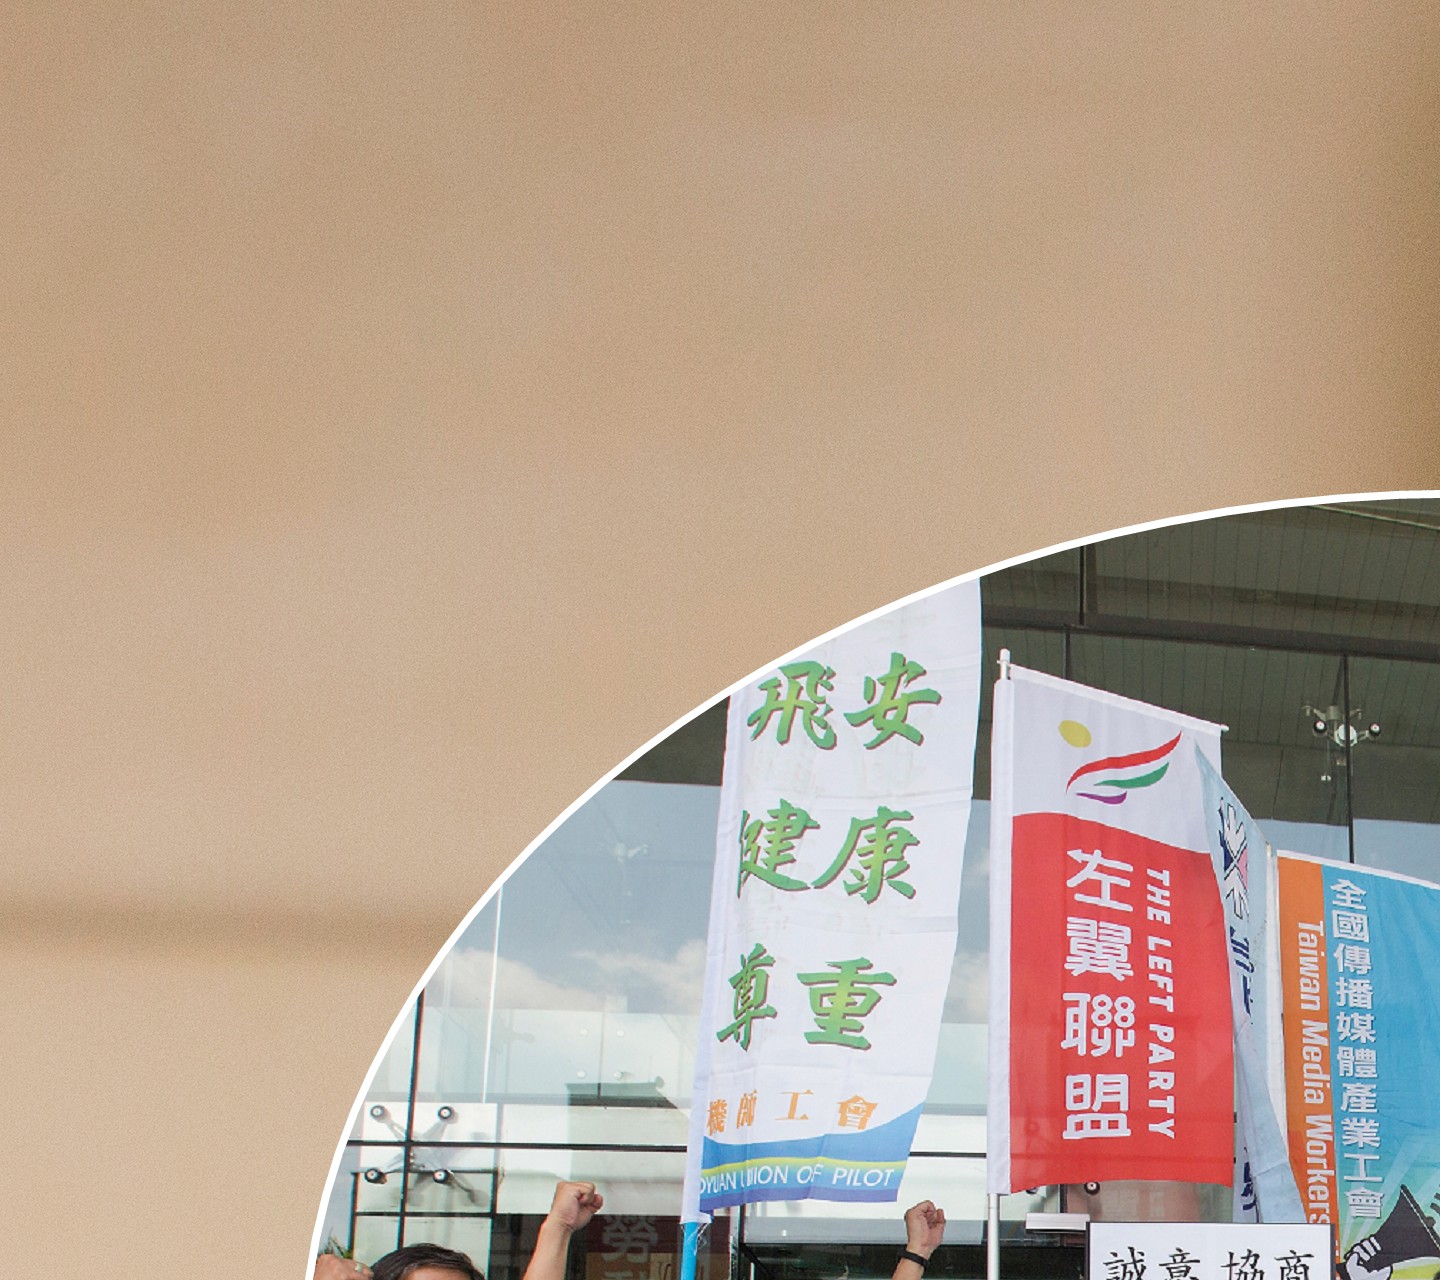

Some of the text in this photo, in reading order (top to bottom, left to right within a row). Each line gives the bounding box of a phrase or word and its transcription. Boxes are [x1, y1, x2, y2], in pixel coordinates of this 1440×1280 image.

[747, 652, 943, 750] 飛安
[737, 798, 920, 904] 健康
[716, 942, 898, 1052] 尊重
[1062, 849, 1136, 1140] 左翼聯盟
[1145, 868, 1176, 1139] THE LEFT PARTY
[1329, 877, 1384, 1220] 全國傳播媒體產業工會
[706, 1090, 879, 1137] 機師工會
[1297, 919, 1336, 1224] Taiwan Media Workers
[796, 1163, 824, 1184] OF
[832, 1168, 895, 1187] PILOT
